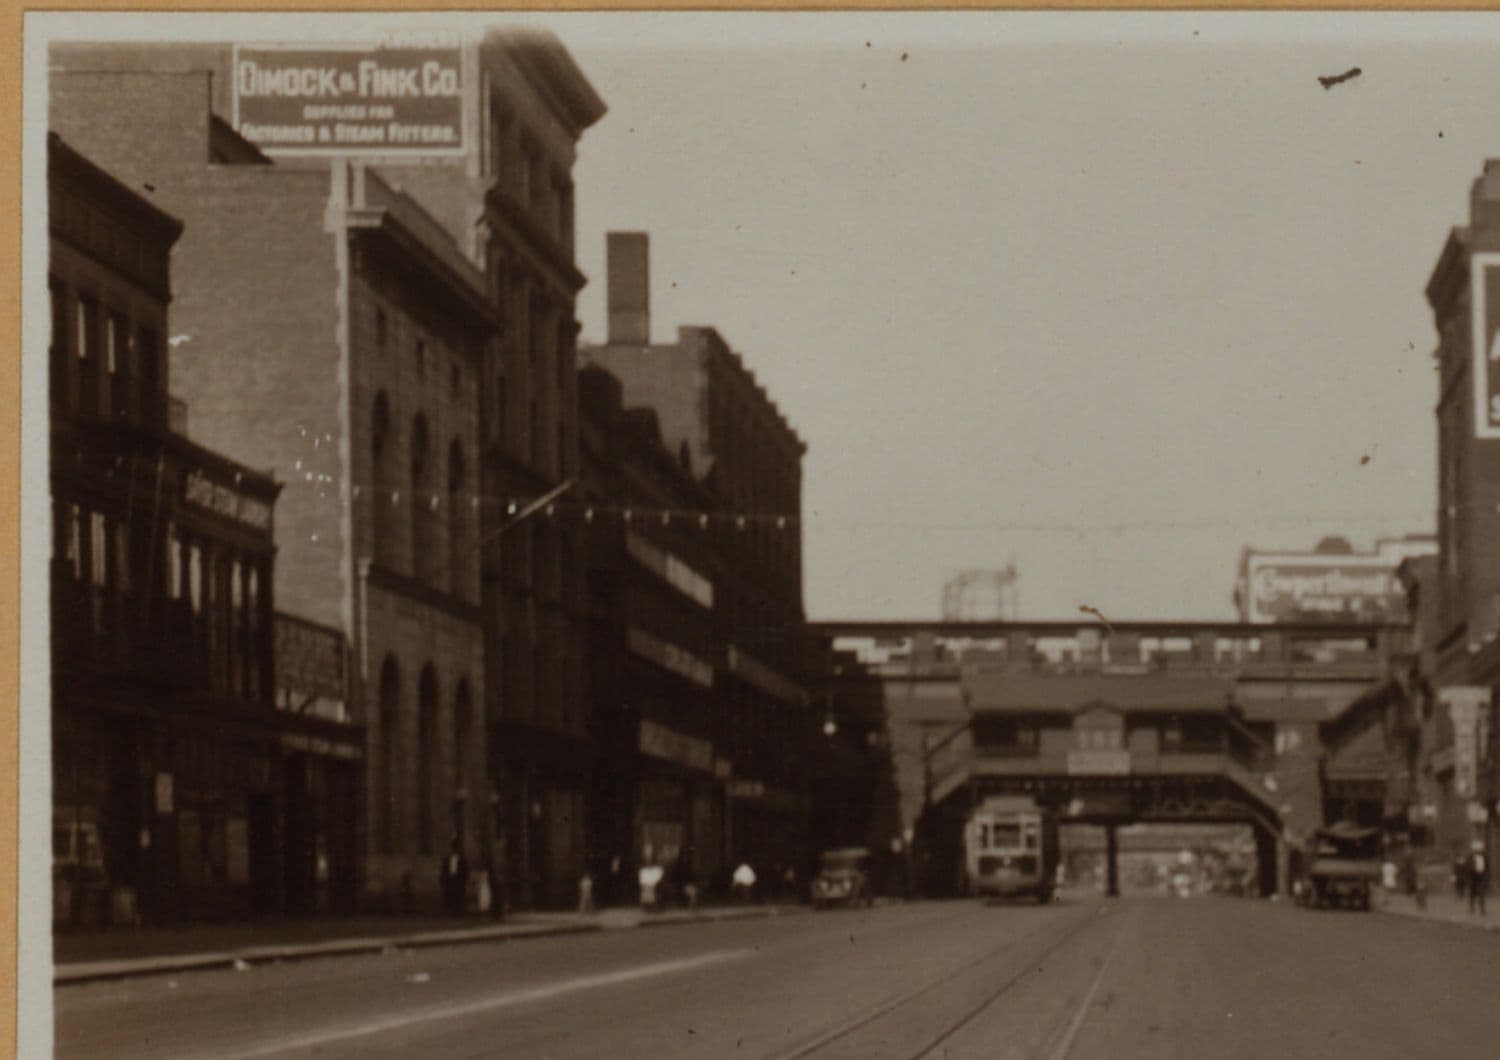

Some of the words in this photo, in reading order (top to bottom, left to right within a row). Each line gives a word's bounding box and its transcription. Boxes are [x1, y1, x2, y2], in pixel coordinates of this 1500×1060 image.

[240, 60, 340, 97] DIMOCK
[359, 60, 420, 97] FINK
[335, 123, 384, 142] STEAM
